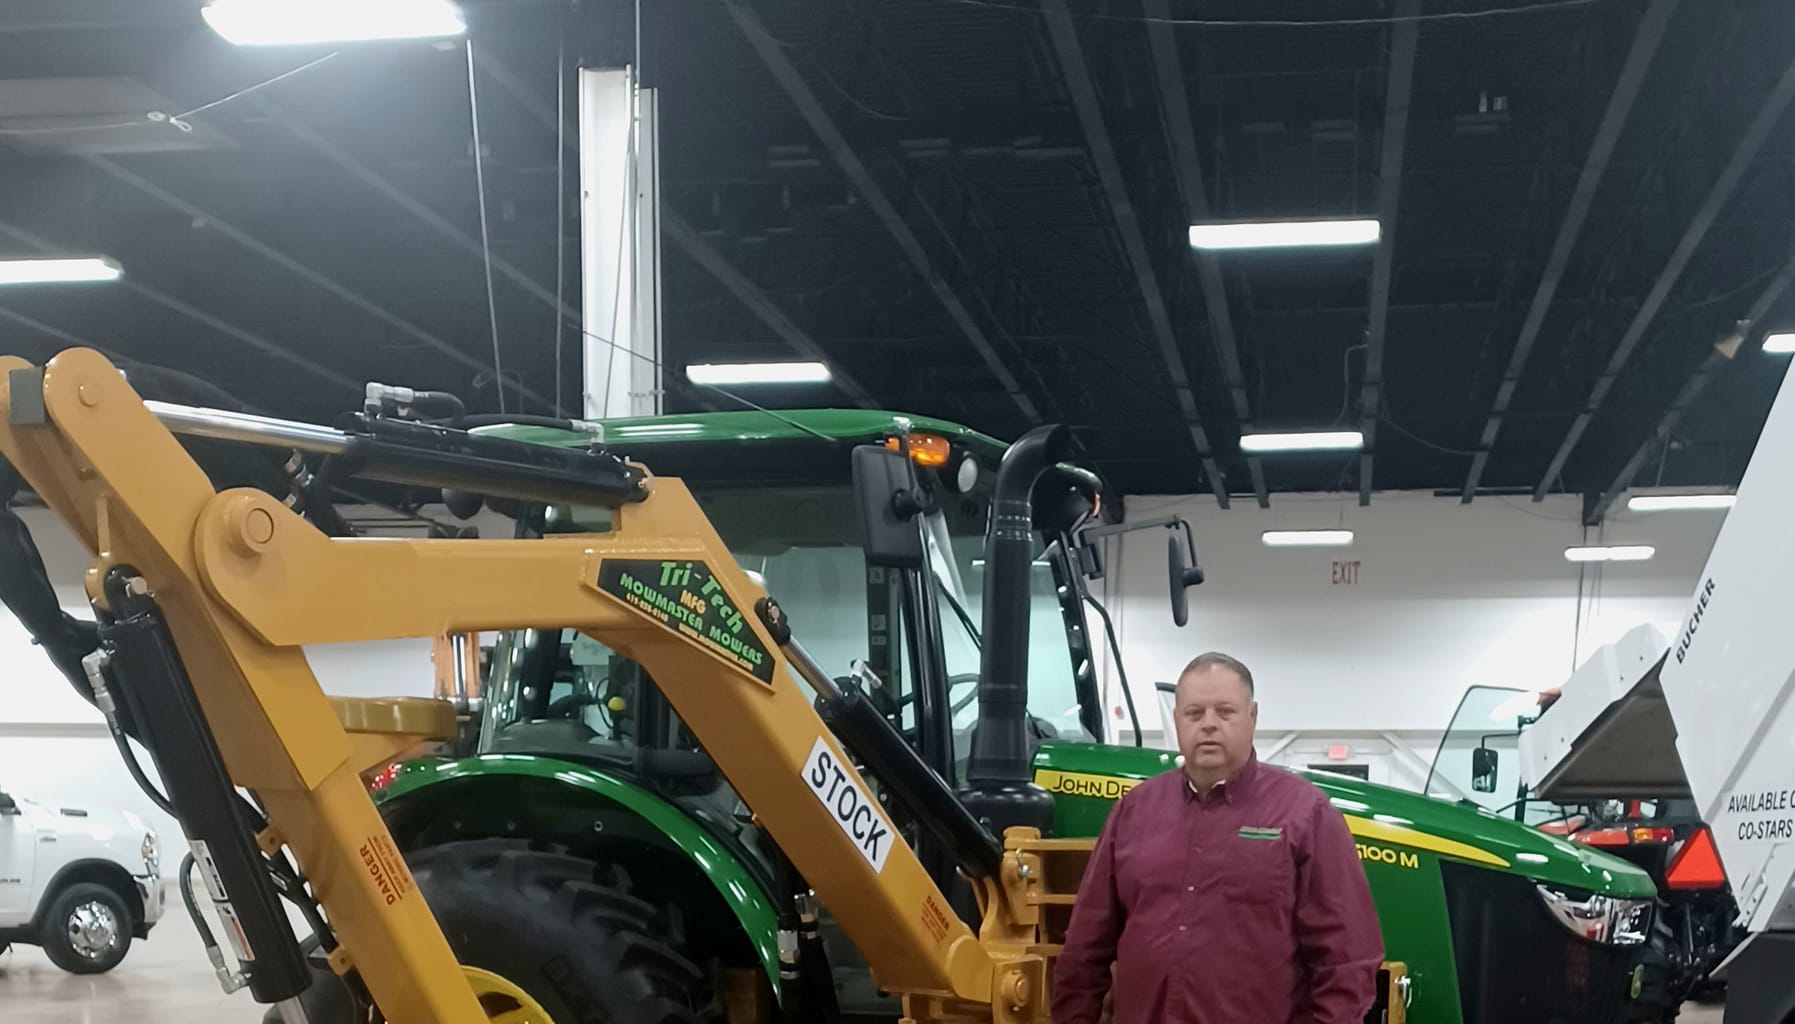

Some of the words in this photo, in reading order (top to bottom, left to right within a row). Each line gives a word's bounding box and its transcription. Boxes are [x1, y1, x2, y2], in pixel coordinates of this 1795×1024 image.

[1332, 561, 1360, 585] EXIT
[660, 561, 743, 634] Tri-Tech
[680, 590, 706, 614] MFG
[620, 573, 704, 630] MOWMASTER
[709, 625, 763, 664] MOWERS
[1676, 578, 1715, 664] BUCHER
[1052, 775, 1102, 795] JOHN
[811, 752, 887, 861] STOCK
[1727, 790, 1788, 813] AVAILABLE
[1738, 819, 1793, 840] CO-STARS
[1400, 851, 1419, 869] M
[360, 844, 396, 905] DANGER
